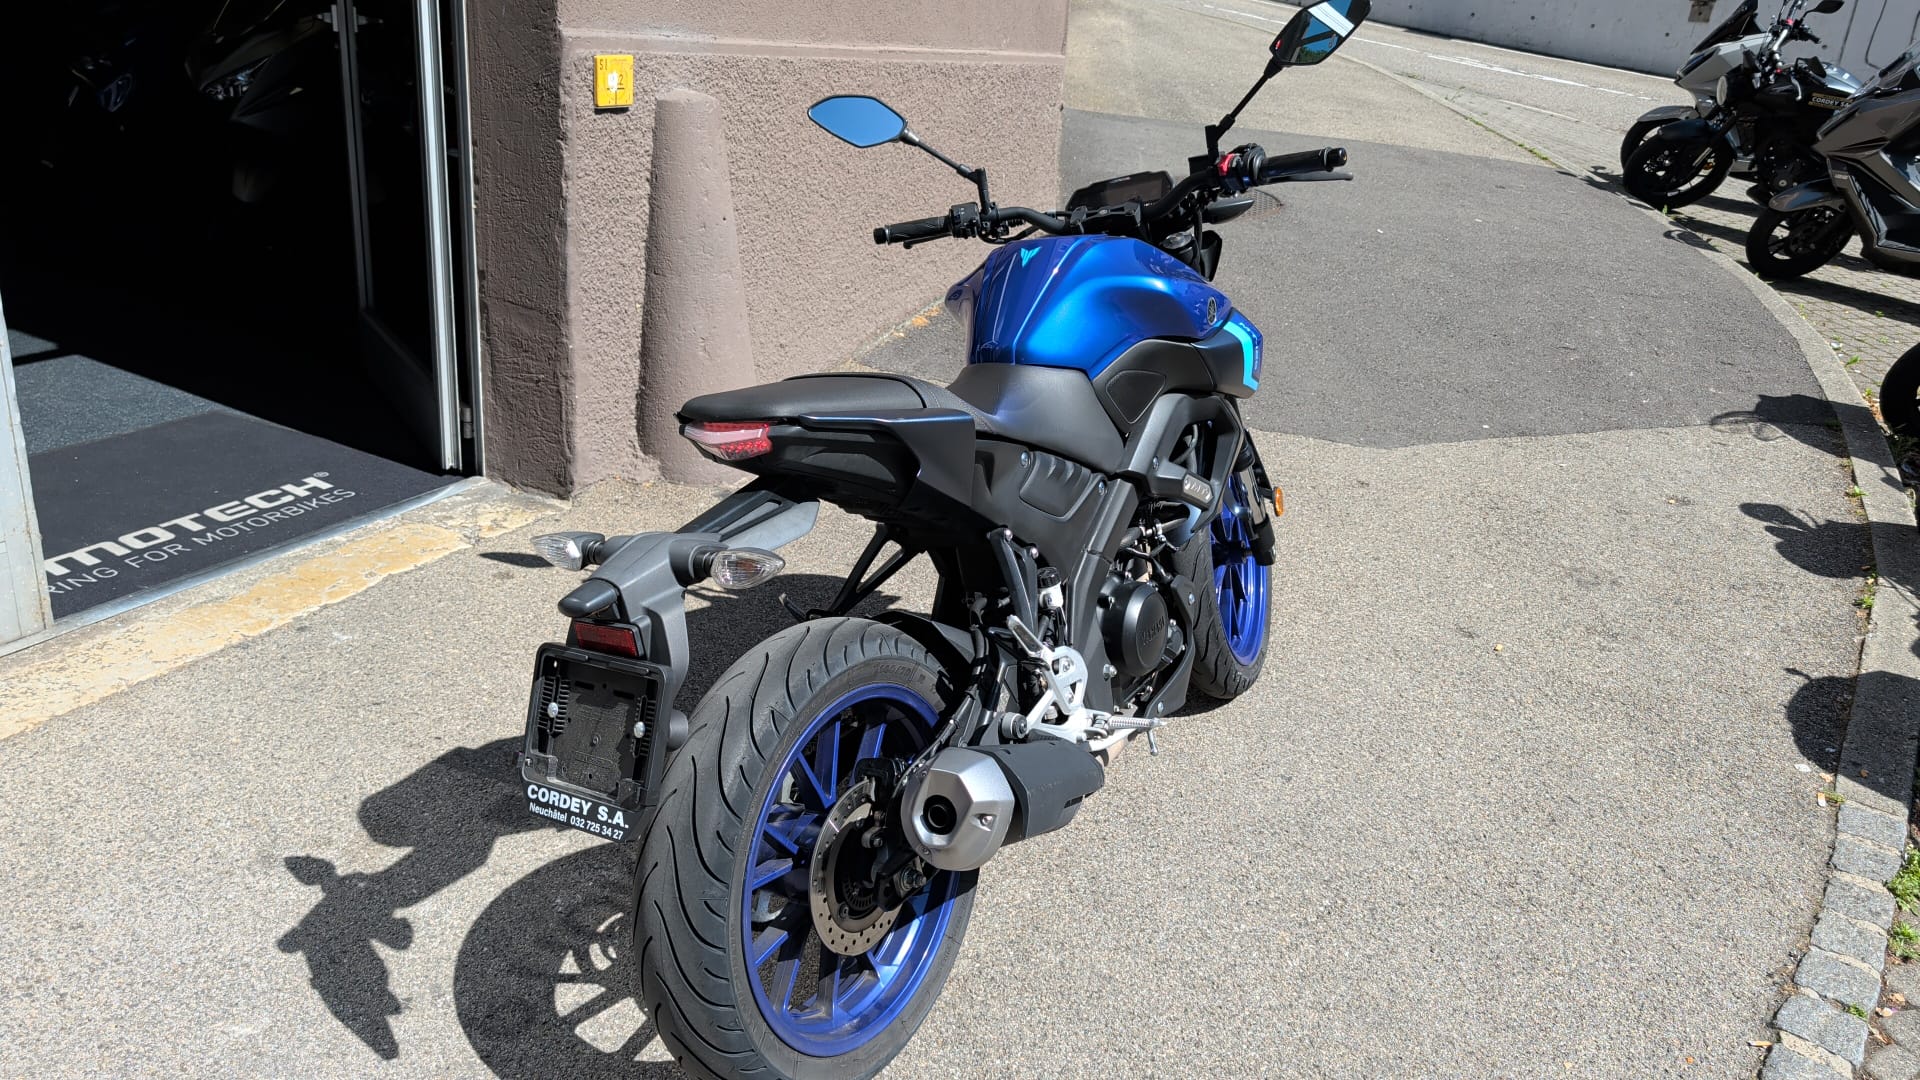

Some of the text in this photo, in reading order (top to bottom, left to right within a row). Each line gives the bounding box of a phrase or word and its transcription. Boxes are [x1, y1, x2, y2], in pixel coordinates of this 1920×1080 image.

[1811, 96, 1840, 106] CORDEY
[124, 542, 192, 569] FOR
[192, 488, 357, 547] MOTORBIKES
[527, 784, 630, 829] CORDEY S.A.
[529, 802, 624, 841] Neuchâtel 032 725 34 27
